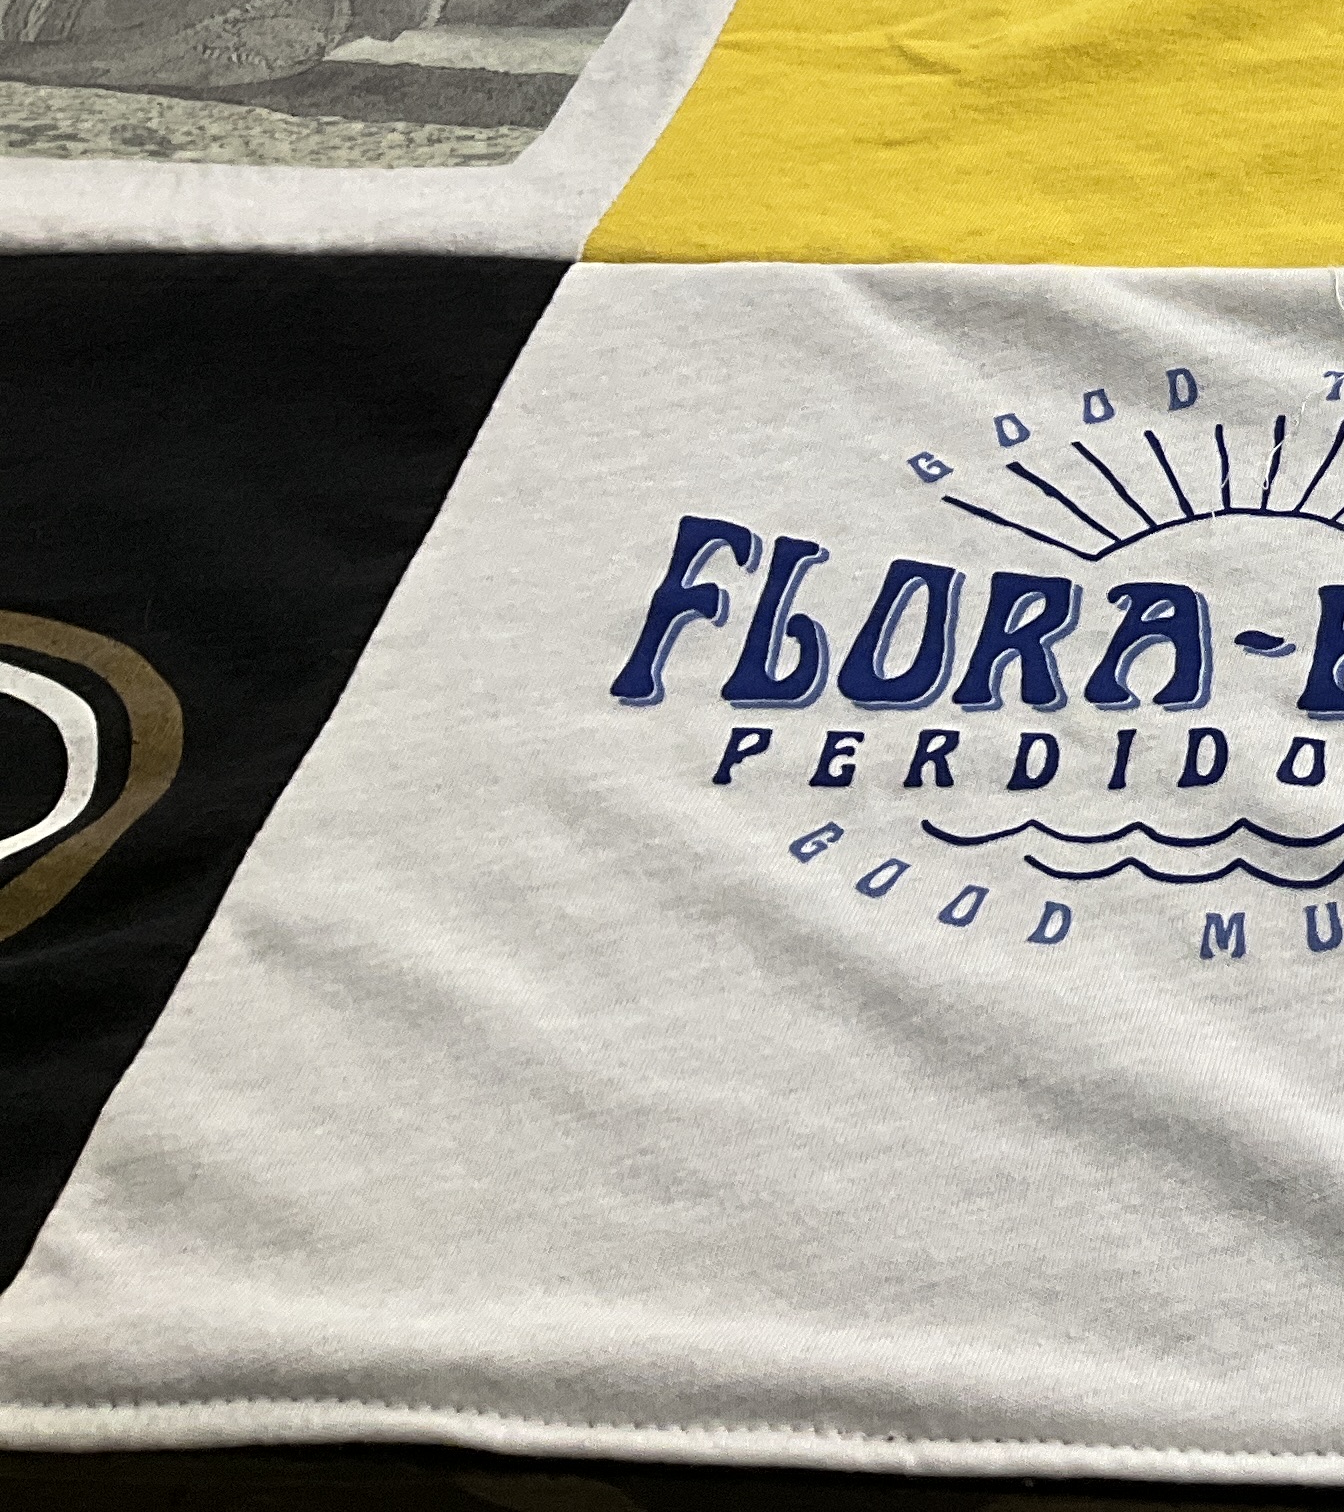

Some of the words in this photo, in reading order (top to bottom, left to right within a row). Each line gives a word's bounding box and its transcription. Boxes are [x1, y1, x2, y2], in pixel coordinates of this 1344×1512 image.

[905, 368, 1199, 488] GOOD
[712, 727, 1329, 794] PERDIDO
[789, 821, 1074, 947] GOOD
